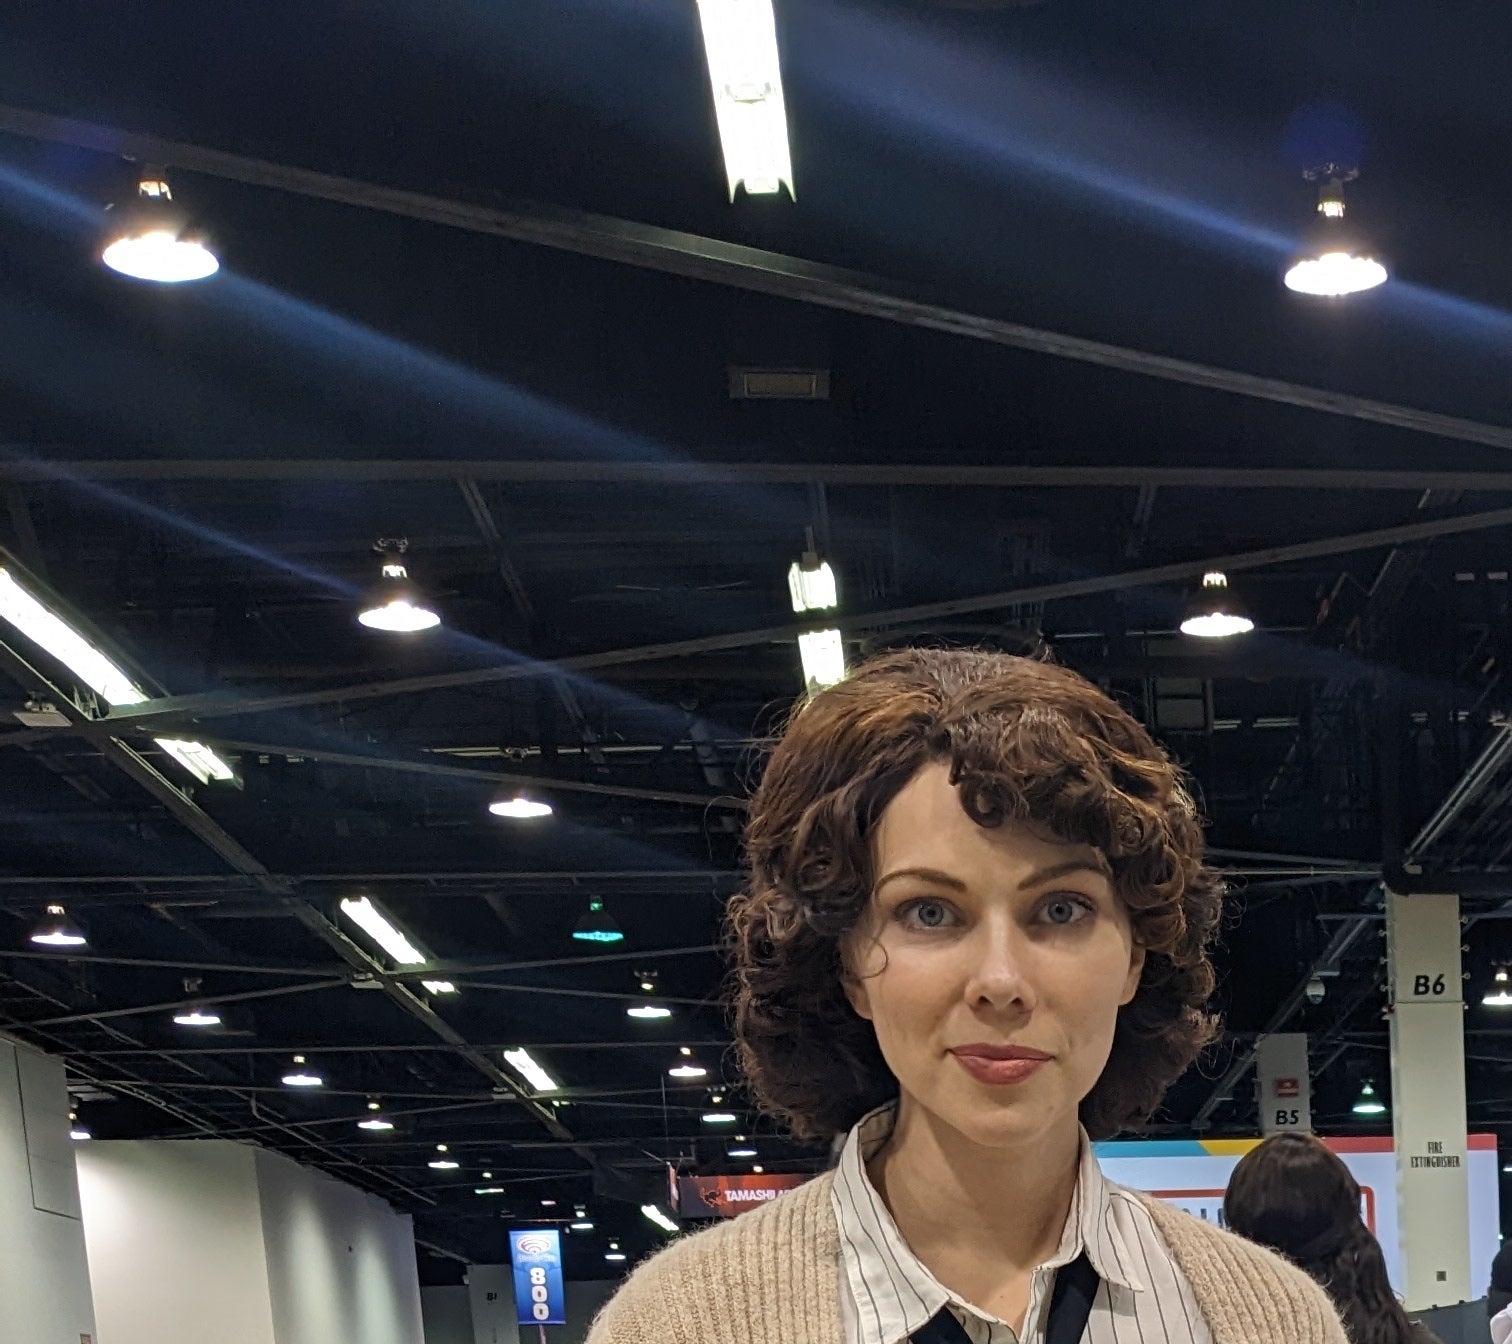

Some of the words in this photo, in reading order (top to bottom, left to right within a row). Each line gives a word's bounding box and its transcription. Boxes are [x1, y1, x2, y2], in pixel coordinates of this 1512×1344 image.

[1414, 974, 1445, 996] B6
[1275, 1110, 1299, 1125] B5
[1427, 1141, 1443, 1154] FIRE
[1410, 1155, 1461, 1168] EXTINGUISHER
[530, 1267, 549, 1320] 800
